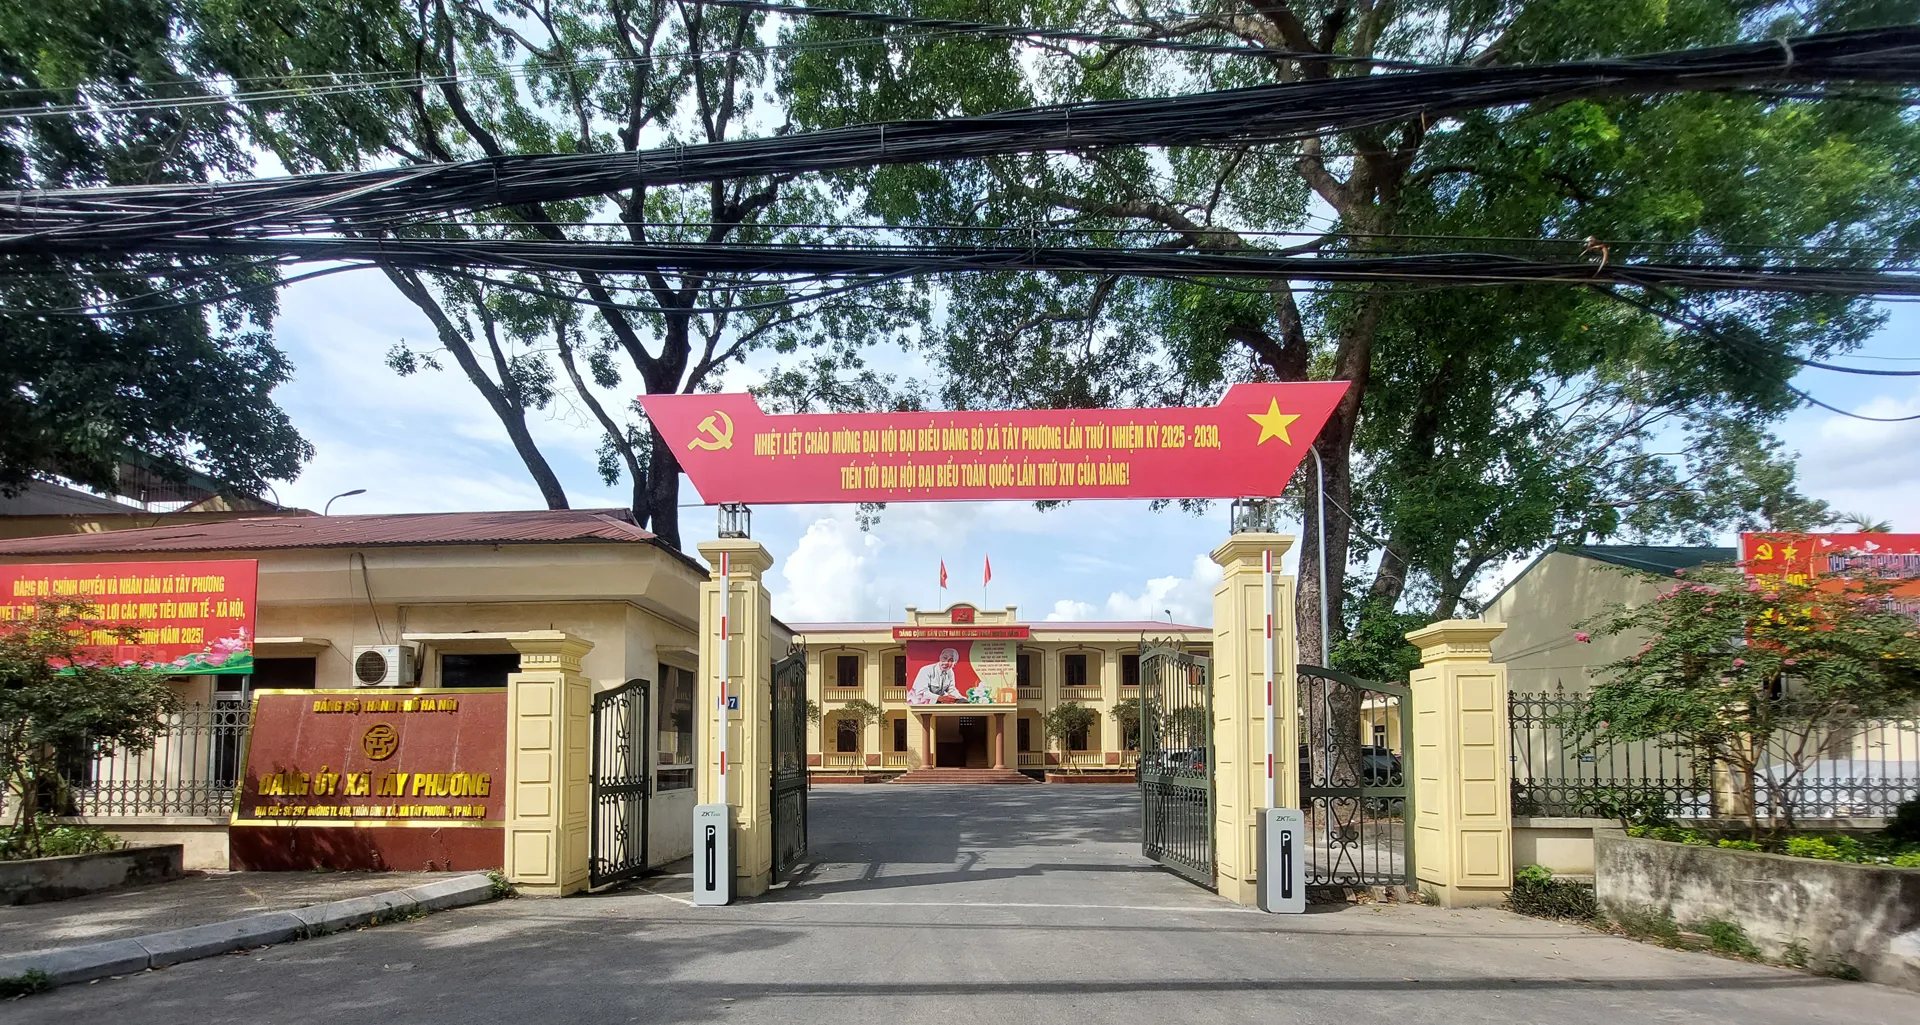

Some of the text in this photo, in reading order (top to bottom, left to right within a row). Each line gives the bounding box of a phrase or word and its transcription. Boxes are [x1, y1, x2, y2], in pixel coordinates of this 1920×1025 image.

[754, 428, 781, 460] NHIỆT
[783, 427, 802, 459] LIỆT
[805, 427, 830, 454] CHÀO
[832, 426, 860, 454] MỪNG
[862, 430, 879, 457] ĐẠI
[881, 425, 897, 457] HỘI
[900, 429, 915, 457] ĐẠI
[918, 420, 939, 452] BIỂU
[942, 421, 968, 451] ĐẢNG
[971, 423, 986, 455] BỘ
[986, 423, 999, 450] XÃ
[1002, 423, 1020, 450] TÂY
[1022, 426, 1061, 450] PHƯƠNG
[1063, 418, 1083, 449] LẦN
[1085, 422, 1105, 449] THỨ
[1106, 426, 1110, 449] I
[1112, 421, 1144, 454] NHIỆM
[1146, 421, 1159, 448] KỲ
[1161, 425, 1185, 448] 2025
[1194, 425, 1221, 450] 2030,
[841, 455, 1130, 493] TIẾN TỚI ĐẠI HỘI ĐẠI BIỂU TOÀN QUỐC LẦN THỨ XIV CỦA ĐẢNG!
[13, 574, 225, 599] ĐẢNG BỘ, CHÍNH QUYỀN VÀ NHÂN DÂN XÃ TÂY PHƯƠNG
[107, 603, 120, 624] LỢI
[121, 600, 137, 619] CÁC
[139, 603, 157, 622] MỤC
[160, 599, 177, 618] TIÊU
[178, 602, 198, 618] KINH
[200, 597, 211, 618] TẾ
[216, 598, 227, 618] XÃ
[229, 598, 245, 621] HỘI,
[161, 625, 179, 644] NĂM
[181, 628, 204, 644] 2025!
[313, 697, 458, 714] ĐẢNG BỘ THÀNH PHỐ HÀ NỘI
[258, 765, 491, 796] ĐẢNG ỦY XÃ TÂY PHƯƠNG
[255, 805, 267, 818] ĐỊA
[283, 803, 293, 816] SỐ
[307, 803, 330, 817] ĐƯỜNG
[330, 806, 338, 816] TL
[339, 806, 352, 817] 419,
[409, 804, 423, 817] TÂY
[453, 806, 461, 816] TP
[462, 804, 472, 816] HÀ
[473, 804, 486, 818] NỘI
[707, 827, 715, 841] P
[1282, 832, 1291, 847] P
